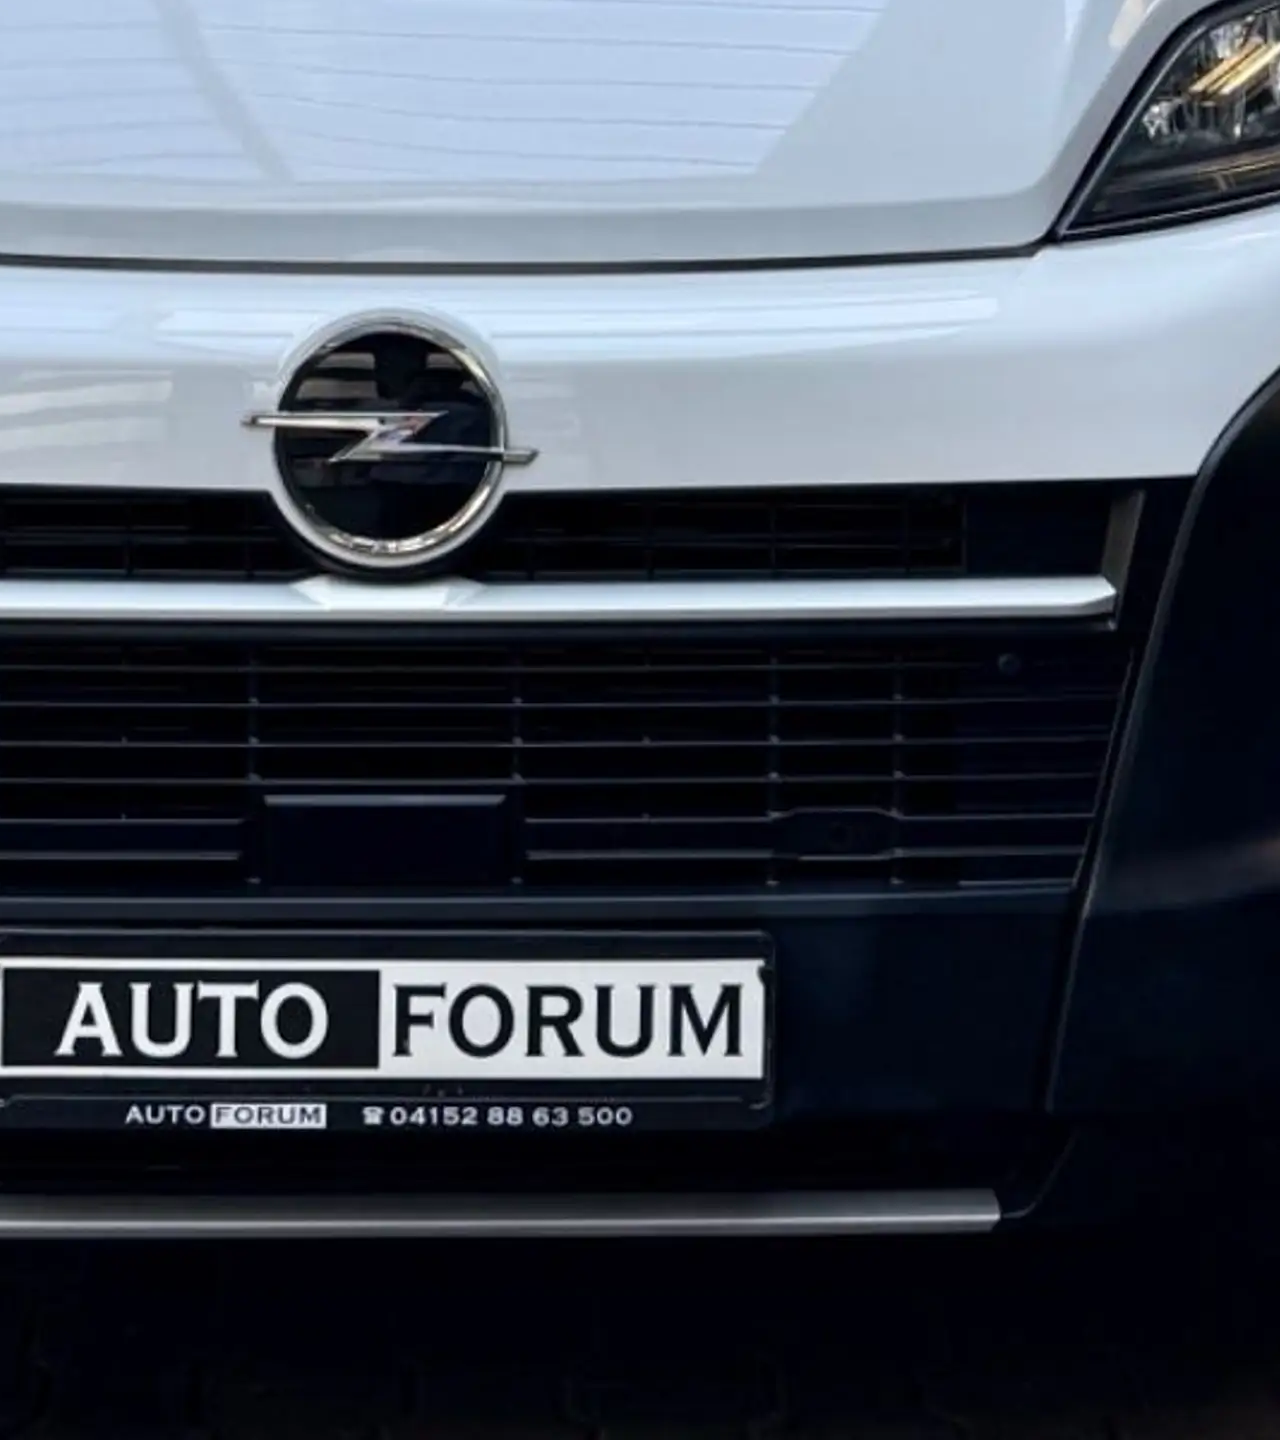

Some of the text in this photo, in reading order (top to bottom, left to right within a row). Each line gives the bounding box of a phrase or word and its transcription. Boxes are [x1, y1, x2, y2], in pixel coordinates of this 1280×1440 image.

[53, 980, 744, 1059] AUTO FORUM
[124, 1103, 634, 1127] AUTO FORUM 04152 88 63 500
